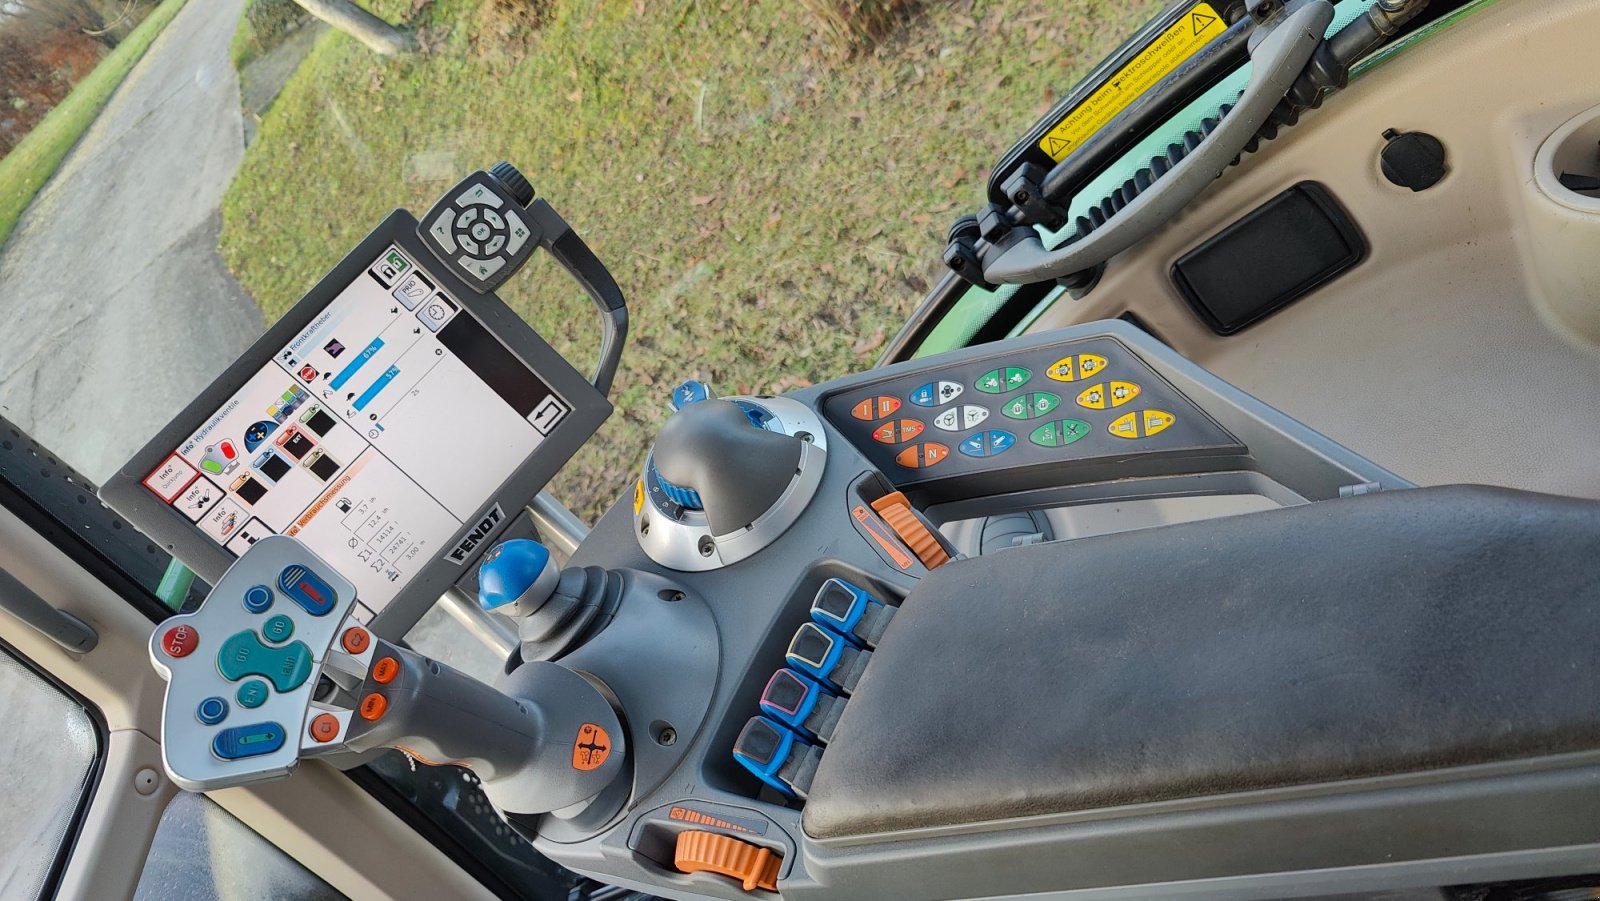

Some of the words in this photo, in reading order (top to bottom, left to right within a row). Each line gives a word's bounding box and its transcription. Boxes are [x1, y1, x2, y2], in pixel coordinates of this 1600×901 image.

[1133, 56, 1163, 85] Schlepper
[1163, 45, 1177, 58] oder
[1176, 37, 1186, 46] an
[1059, 104, 1092, 134] Achtung
[1090, 87, 1113, 106] beim
[1112, 24, 1185, 88] Elektroschweißen
[1134, 63, 1171, 93] Batteriepole
[477, 227, 487, 236] OK
[401, 280, 416, 294] PRIO
[289, 311, 332, 351] Frontkraftheber
[363, 345, 377, 359] 67%
[411, 389, 420, 397] 2s
[194, 399, 240, 443] Hydraulikventile
[928, 449, 937, 458] N
[298, 475, 351, 527] Verbrauchsmessung
[450, 507, 501, 561] FENDT
[274, 620, 285, 634] GO
[170, 626, 189, 655] STOP
[350, 633, 365, 647] C2
[236, 648, 250, 662] GO
[280, 655, 296, 676] END
[377, 661, 389, 678] MAX
[365, 697, 378, 712] MIN
[320, 721, 332, 734] C1
